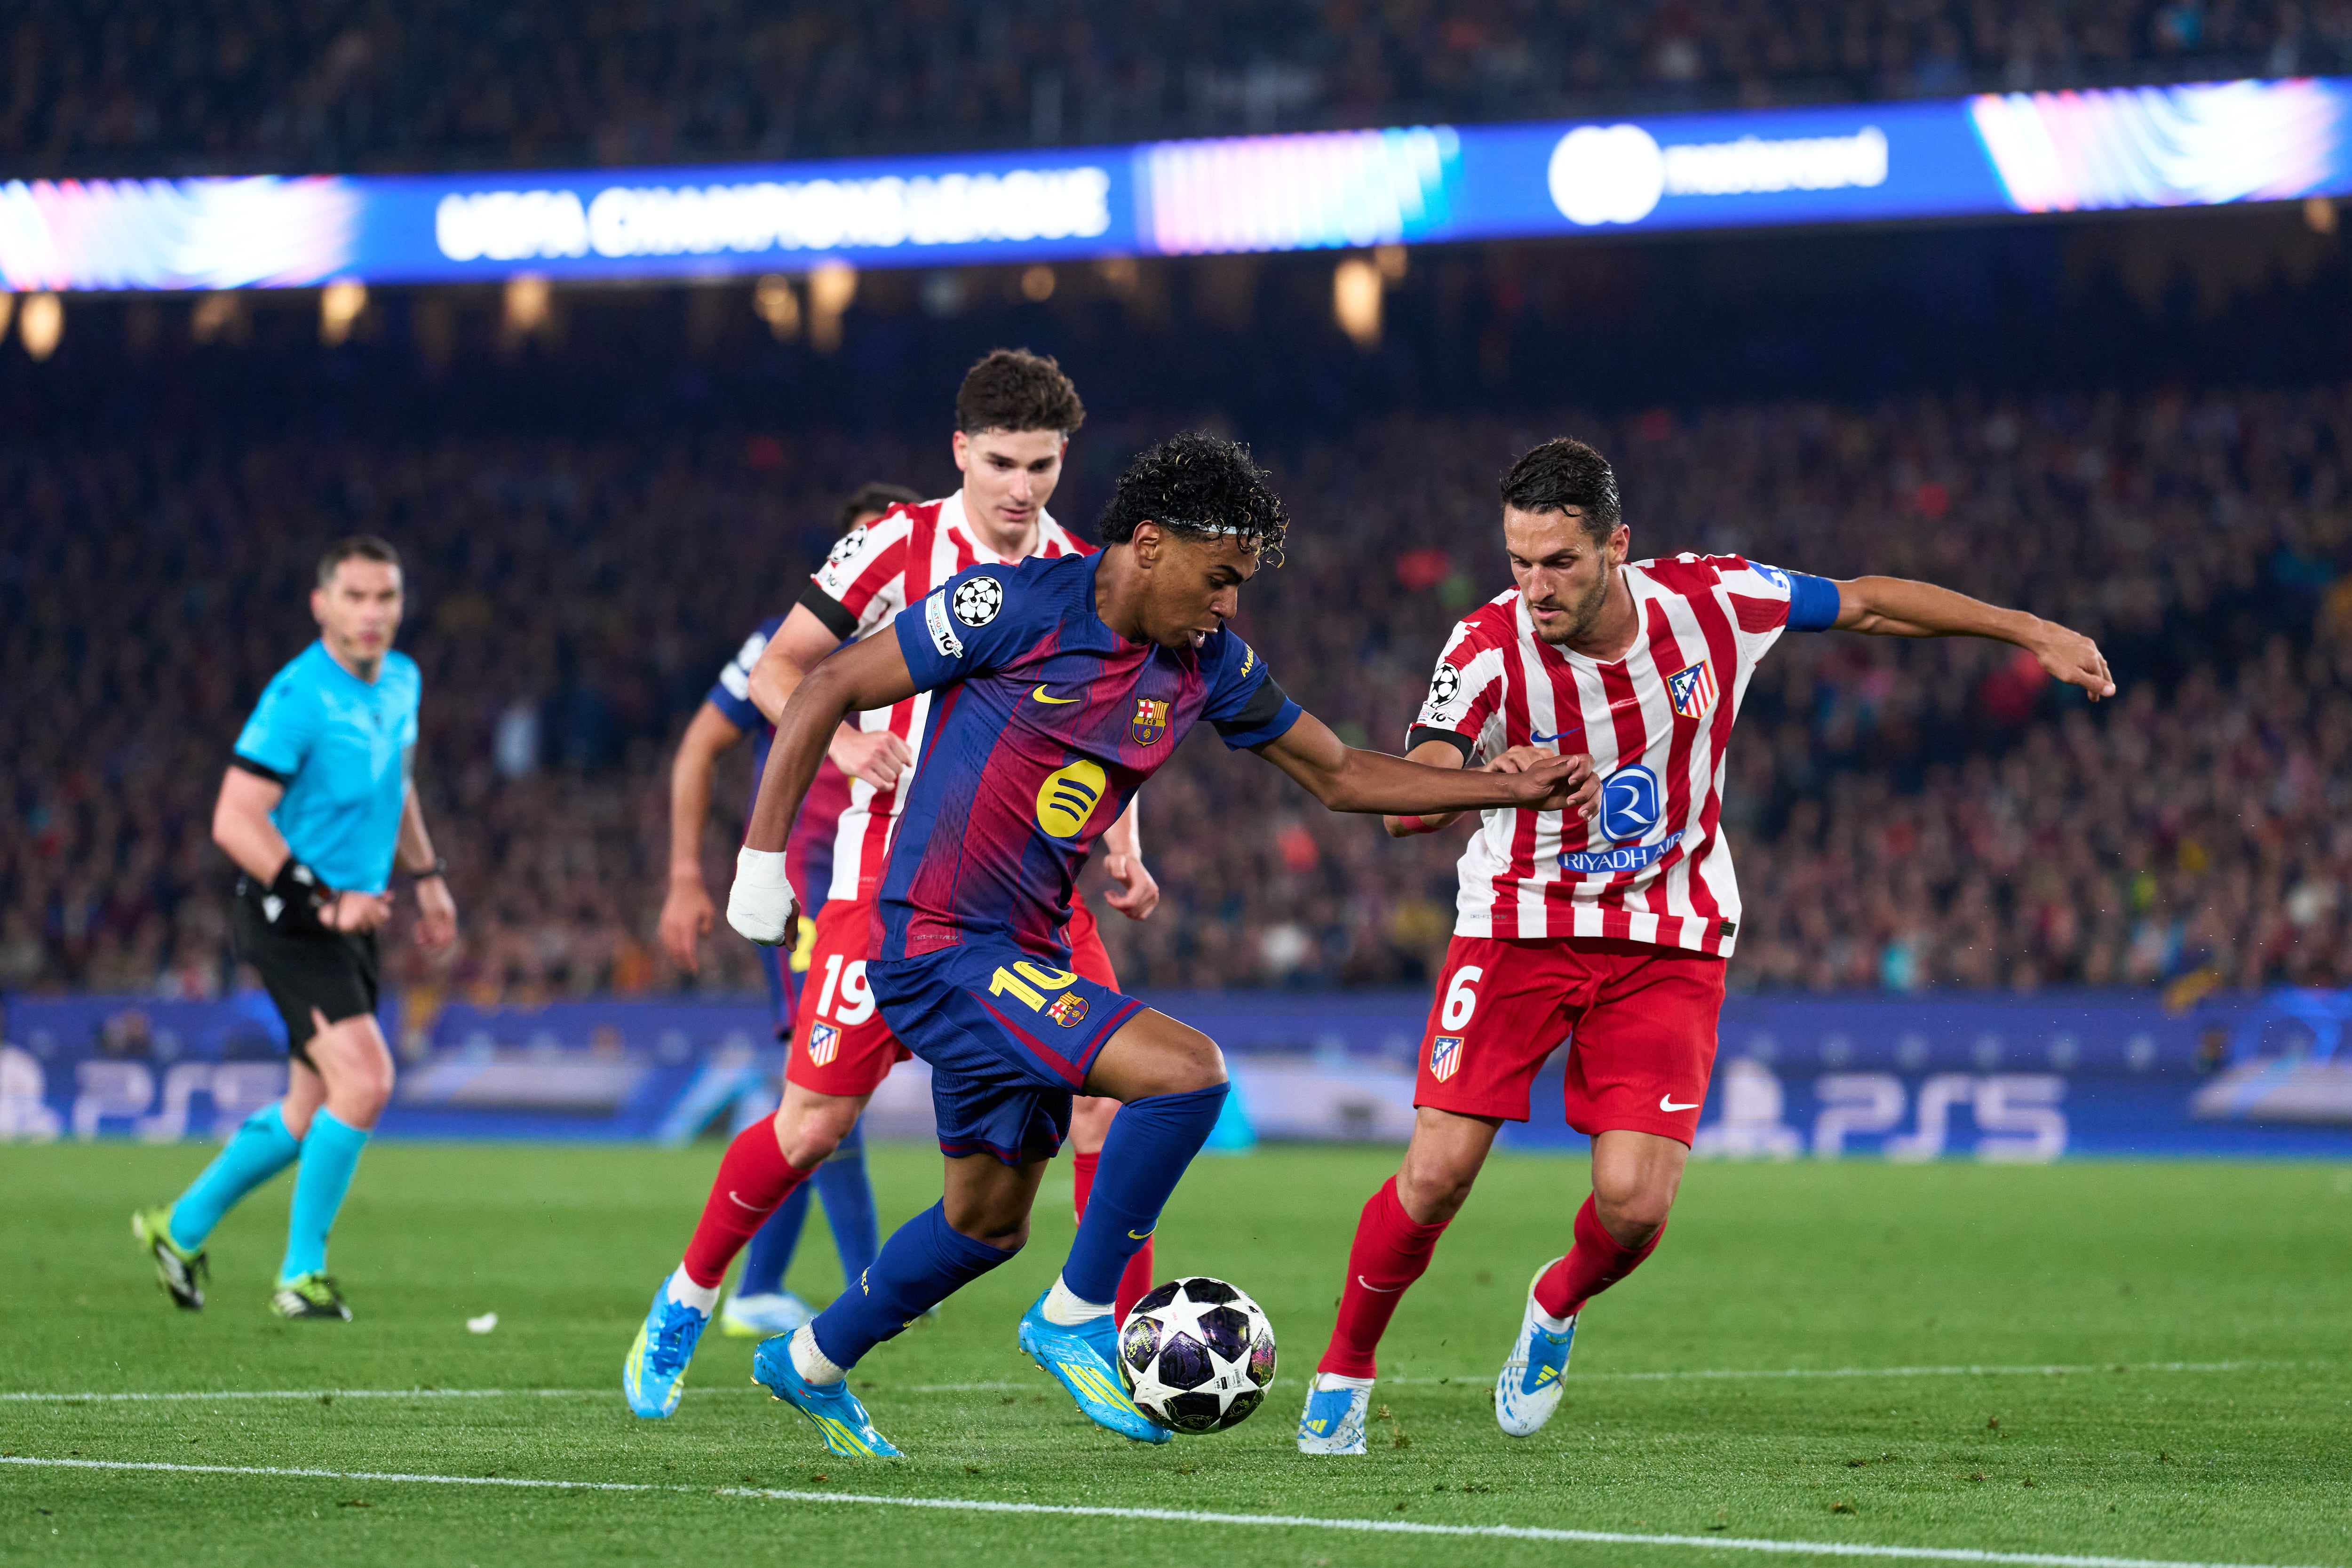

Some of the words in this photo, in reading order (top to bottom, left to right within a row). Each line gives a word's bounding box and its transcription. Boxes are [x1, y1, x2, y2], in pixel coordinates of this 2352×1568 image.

[933, 594, 944, 633] FOUNDATION
[967, 591, 987, 607] 5
[939, 632, 954, 651] 10
[1564, 849, 1647, 870] RIYADH
[1653, 832, 1683, 860] AIR
[816, 954, 875, 1026] 19
[988, 961, 1078, 1013] 10
[1441, 965, 1483, 1031] 6
[1063, 1003, 1075, 1015] FCB
[1811, 1073, 2068, 1163] PS5
